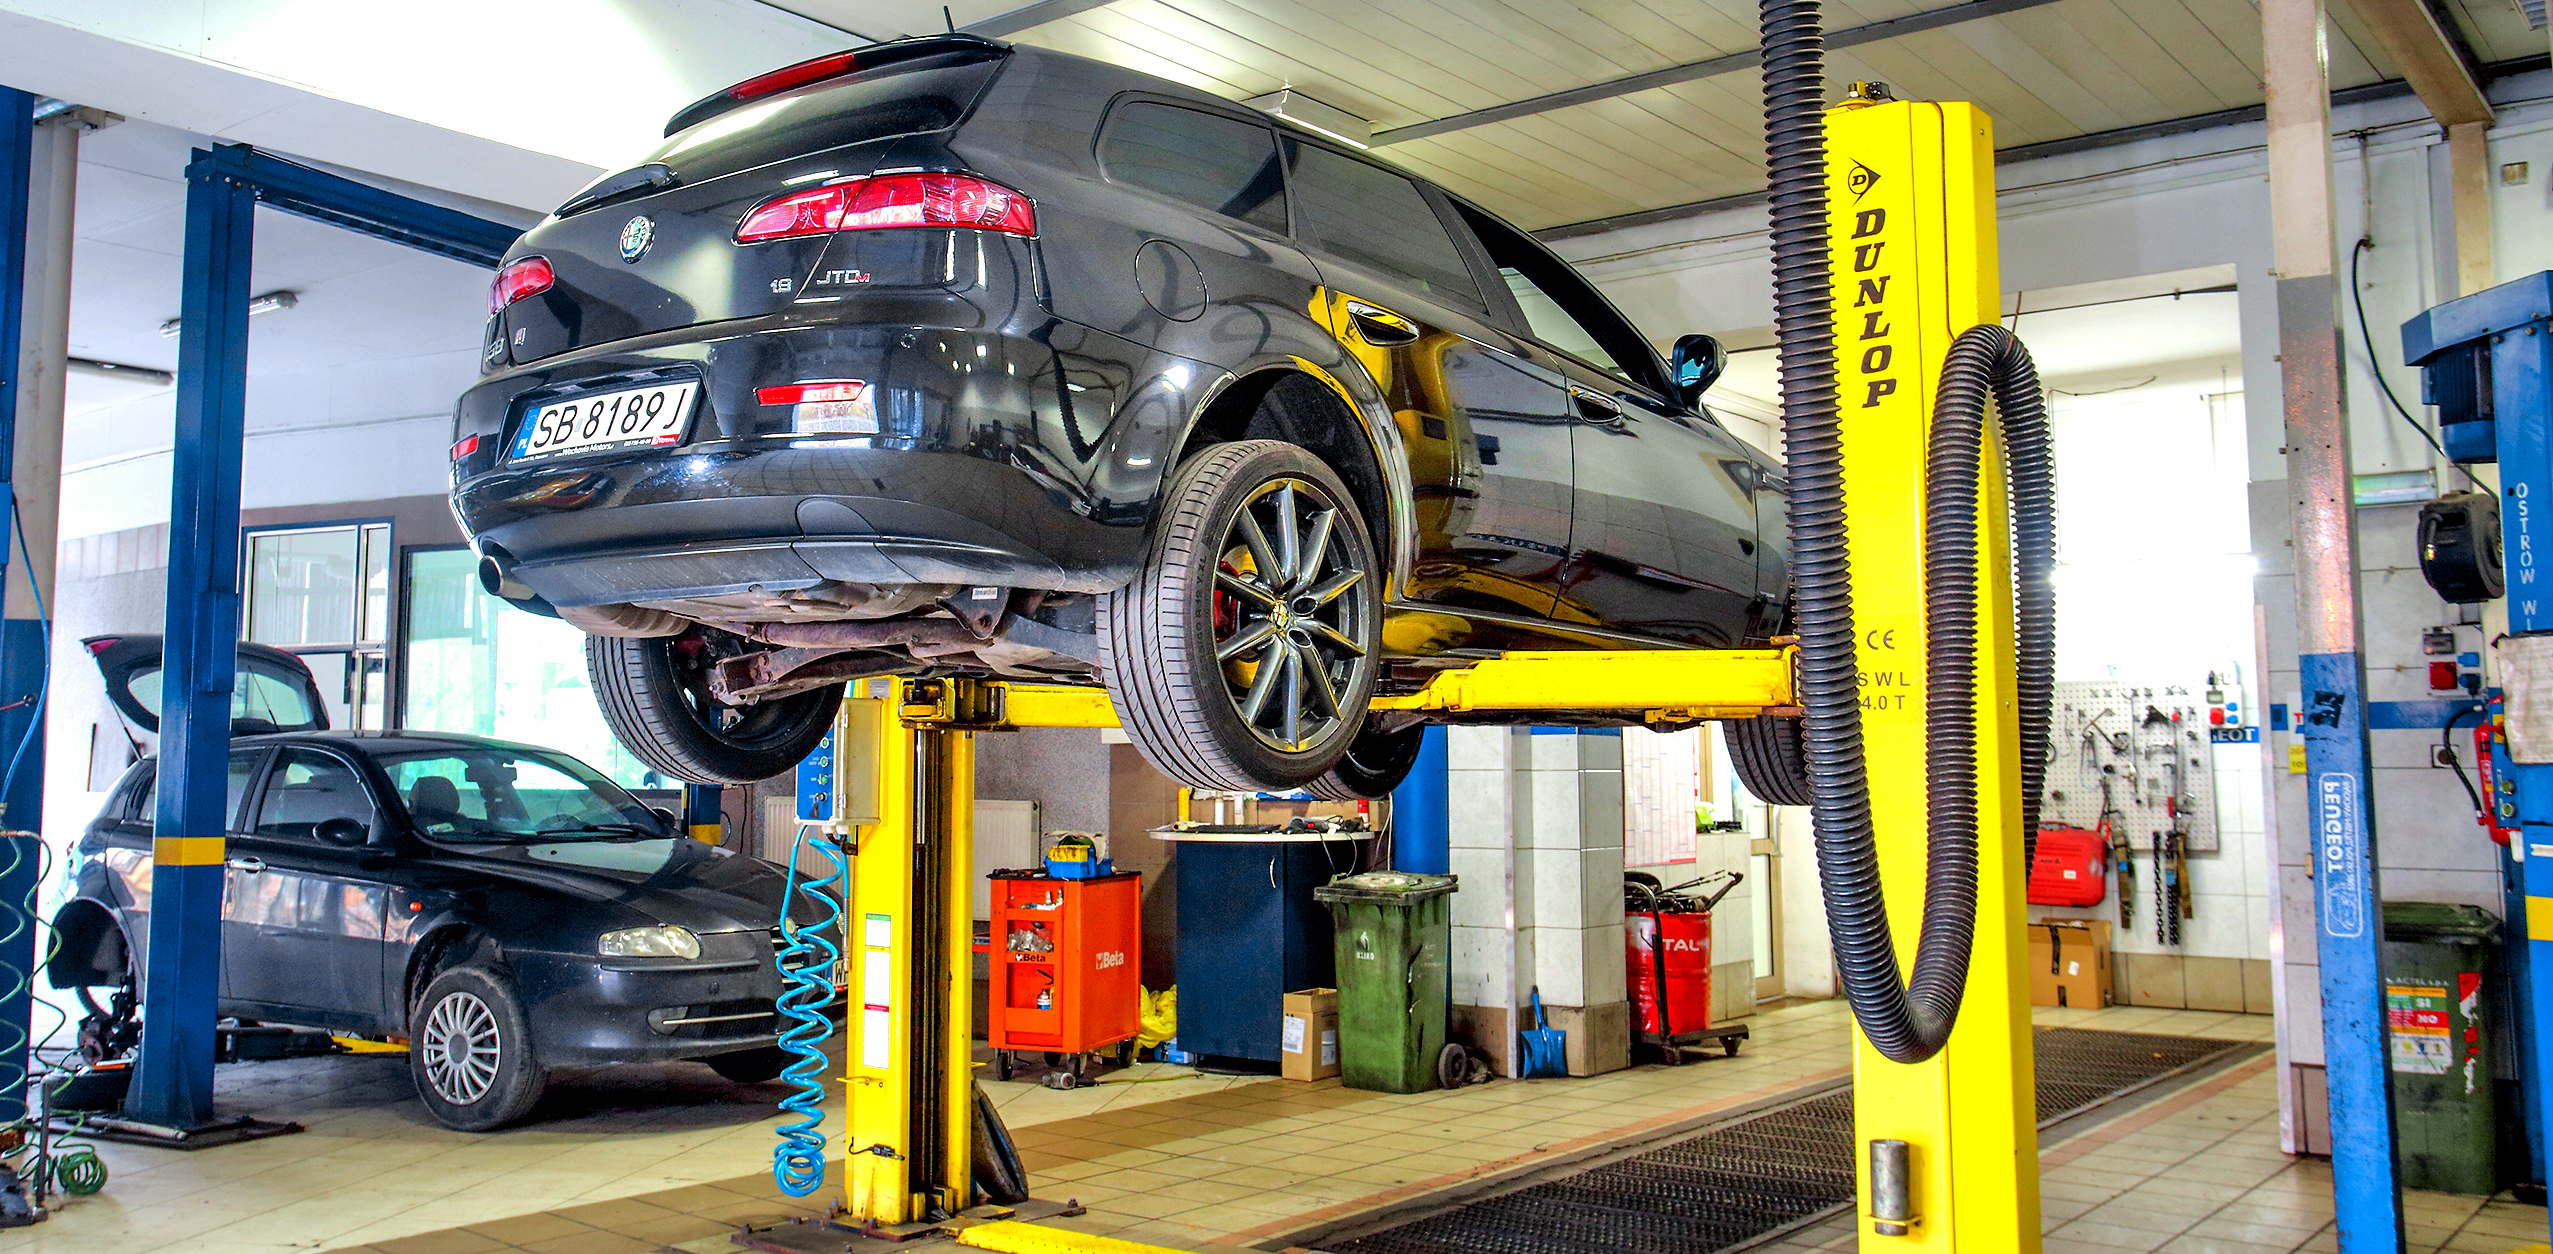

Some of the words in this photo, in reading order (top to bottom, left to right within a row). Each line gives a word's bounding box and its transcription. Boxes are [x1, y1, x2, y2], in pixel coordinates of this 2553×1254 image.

[1850, 208, 1897, 409] DUNLOP
[534, 405, 578, 449] SB
[582, 388, 688, 440] 8189J
[517, 438, 529, 450] PL
[1861, 695, 1888, 710] 4.0
[1894, 694, 1906, 710] T
[2213, 728, 2256, 742] EOT
[1662, 939, 1699, 951] TAL
[1023, 953, 1046, 962] Beta
[1103, 950, 1124, 968] Beta
[2417, 1014, 2439, 1024] NO
